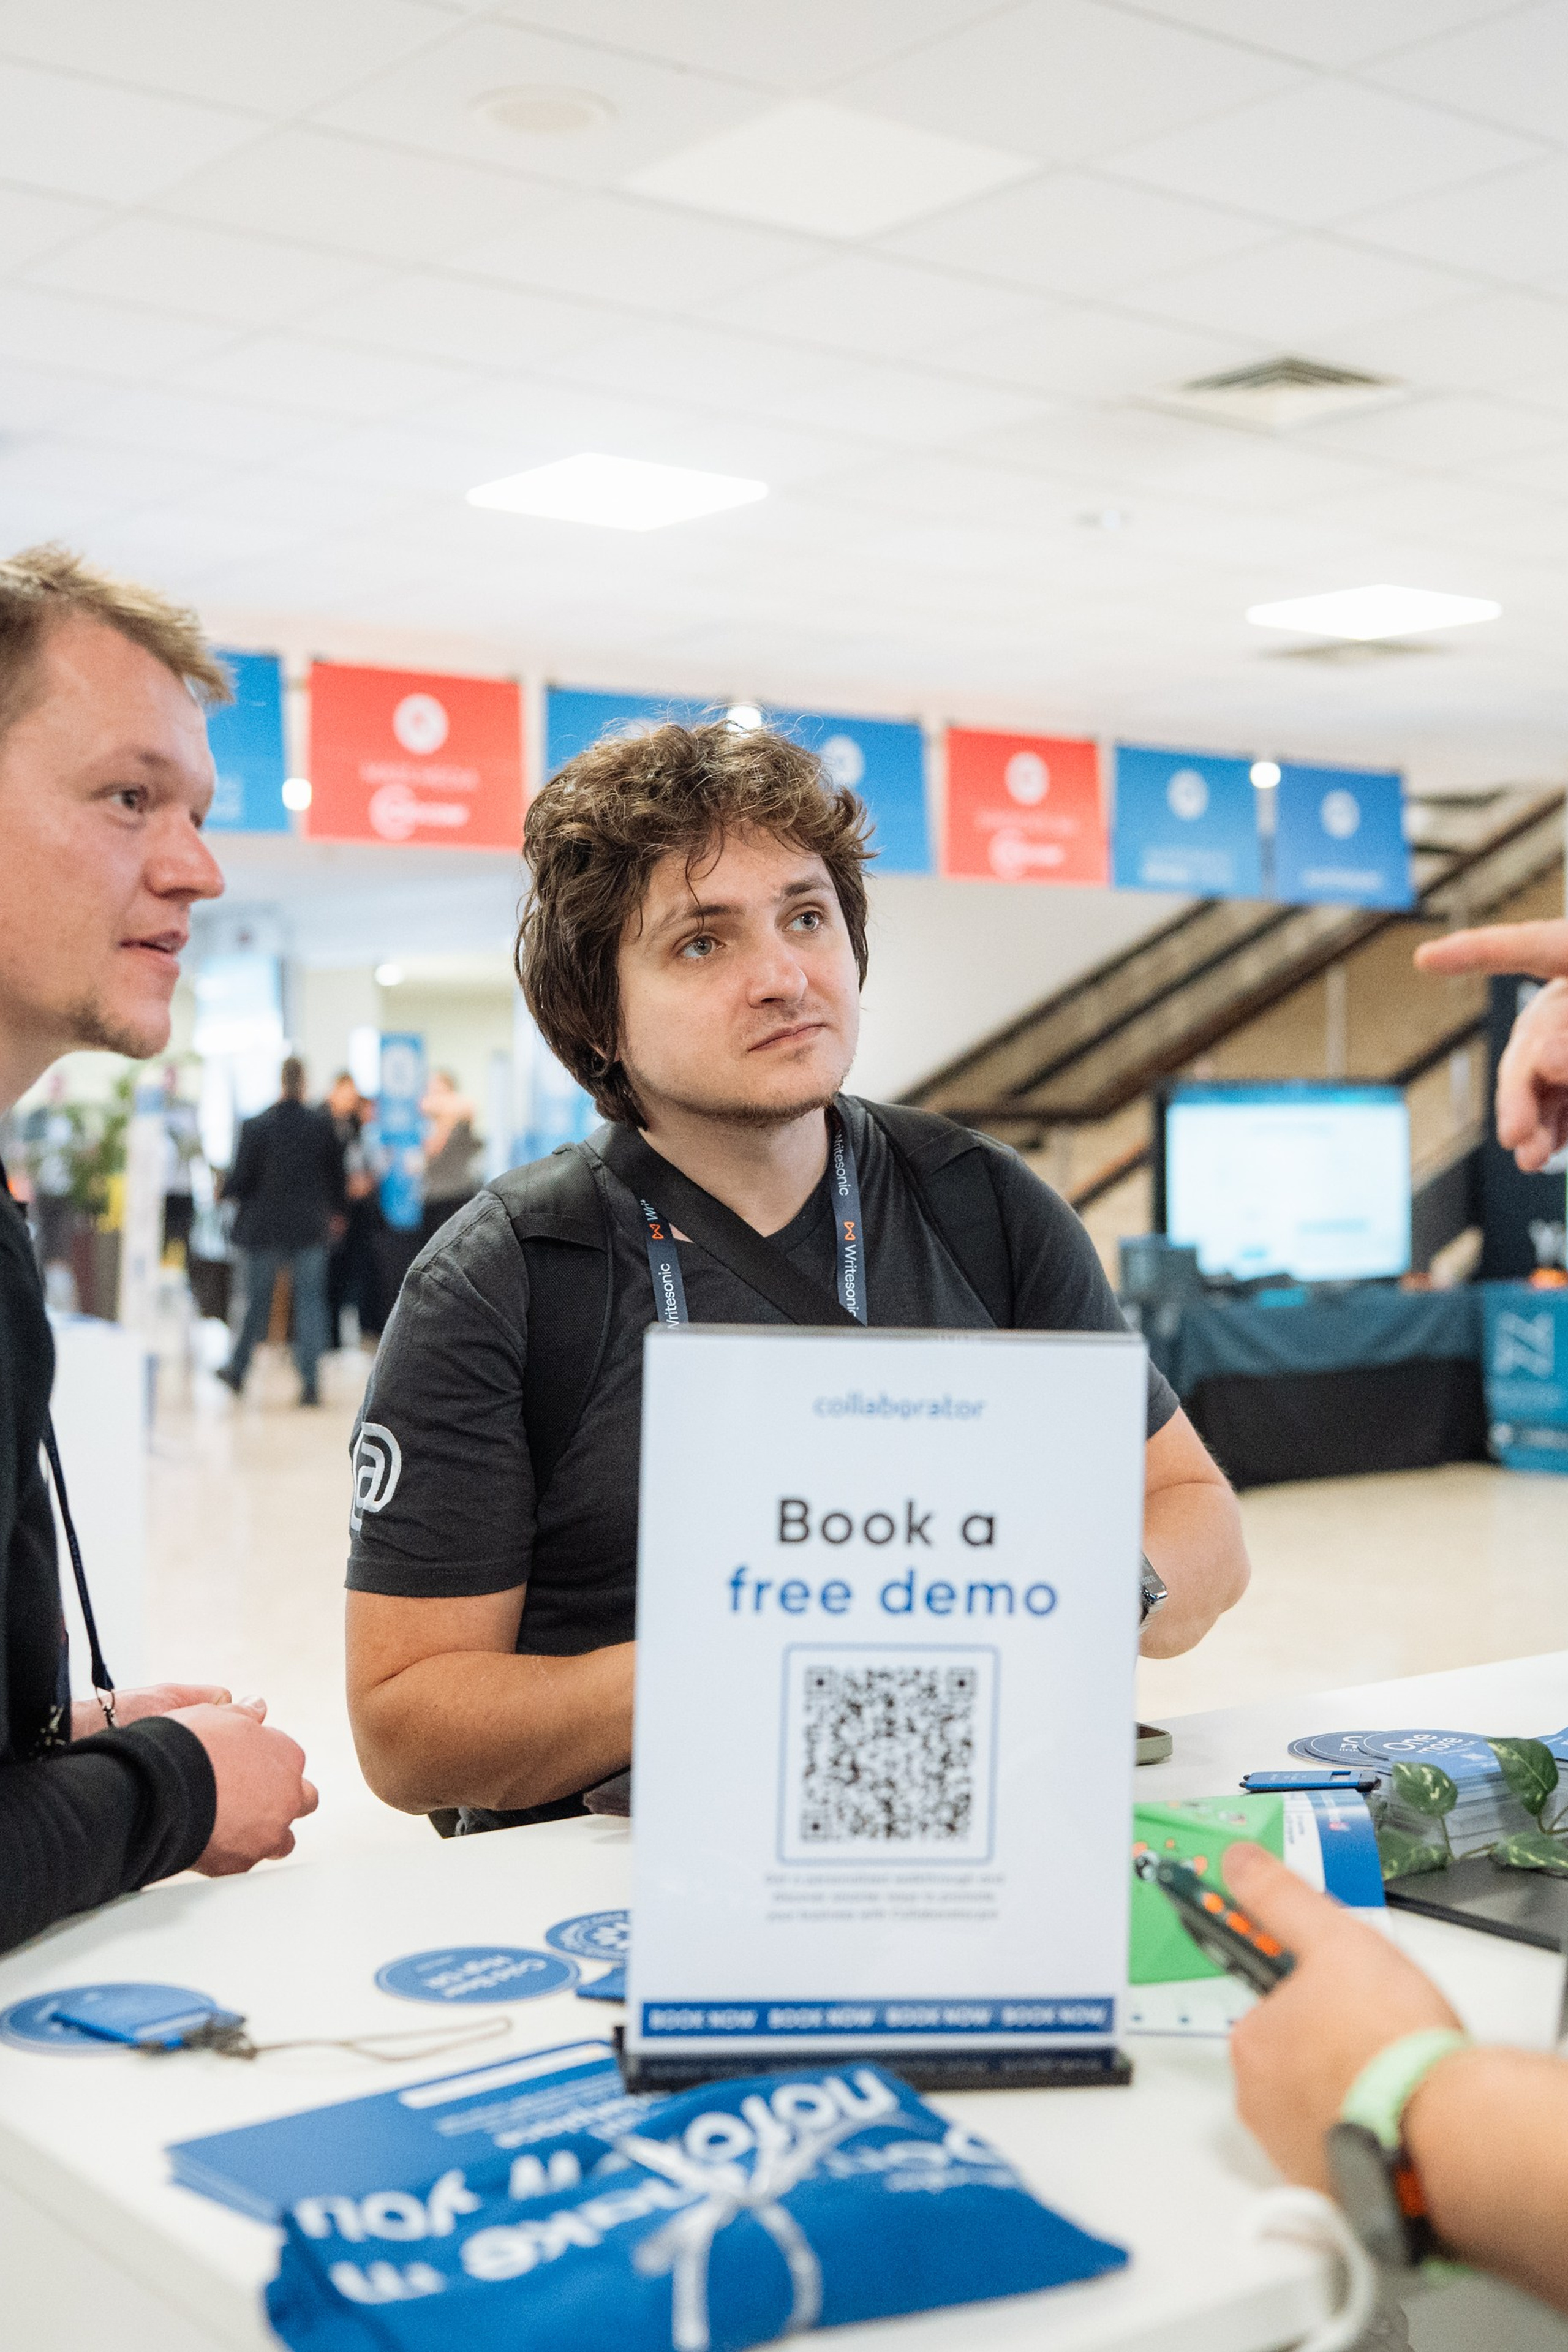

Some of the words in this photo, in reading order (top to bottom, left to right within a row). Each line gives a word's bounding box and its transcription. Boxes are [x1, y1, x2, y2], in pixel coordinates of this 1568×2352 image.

[833, 1129, 851, 1196] Writesonic
[813, 1391, 985, 1422] collaborator
[778, 1498, 932, 1545] Book
[960, 1513, 995, 1547] a
[728, 1566, 852, 1615] free
[879, 1568, 1057, 1616] demo
[1382, 1733, 1438, 1751] One
[1415, 1737, 1463, 1754] more
